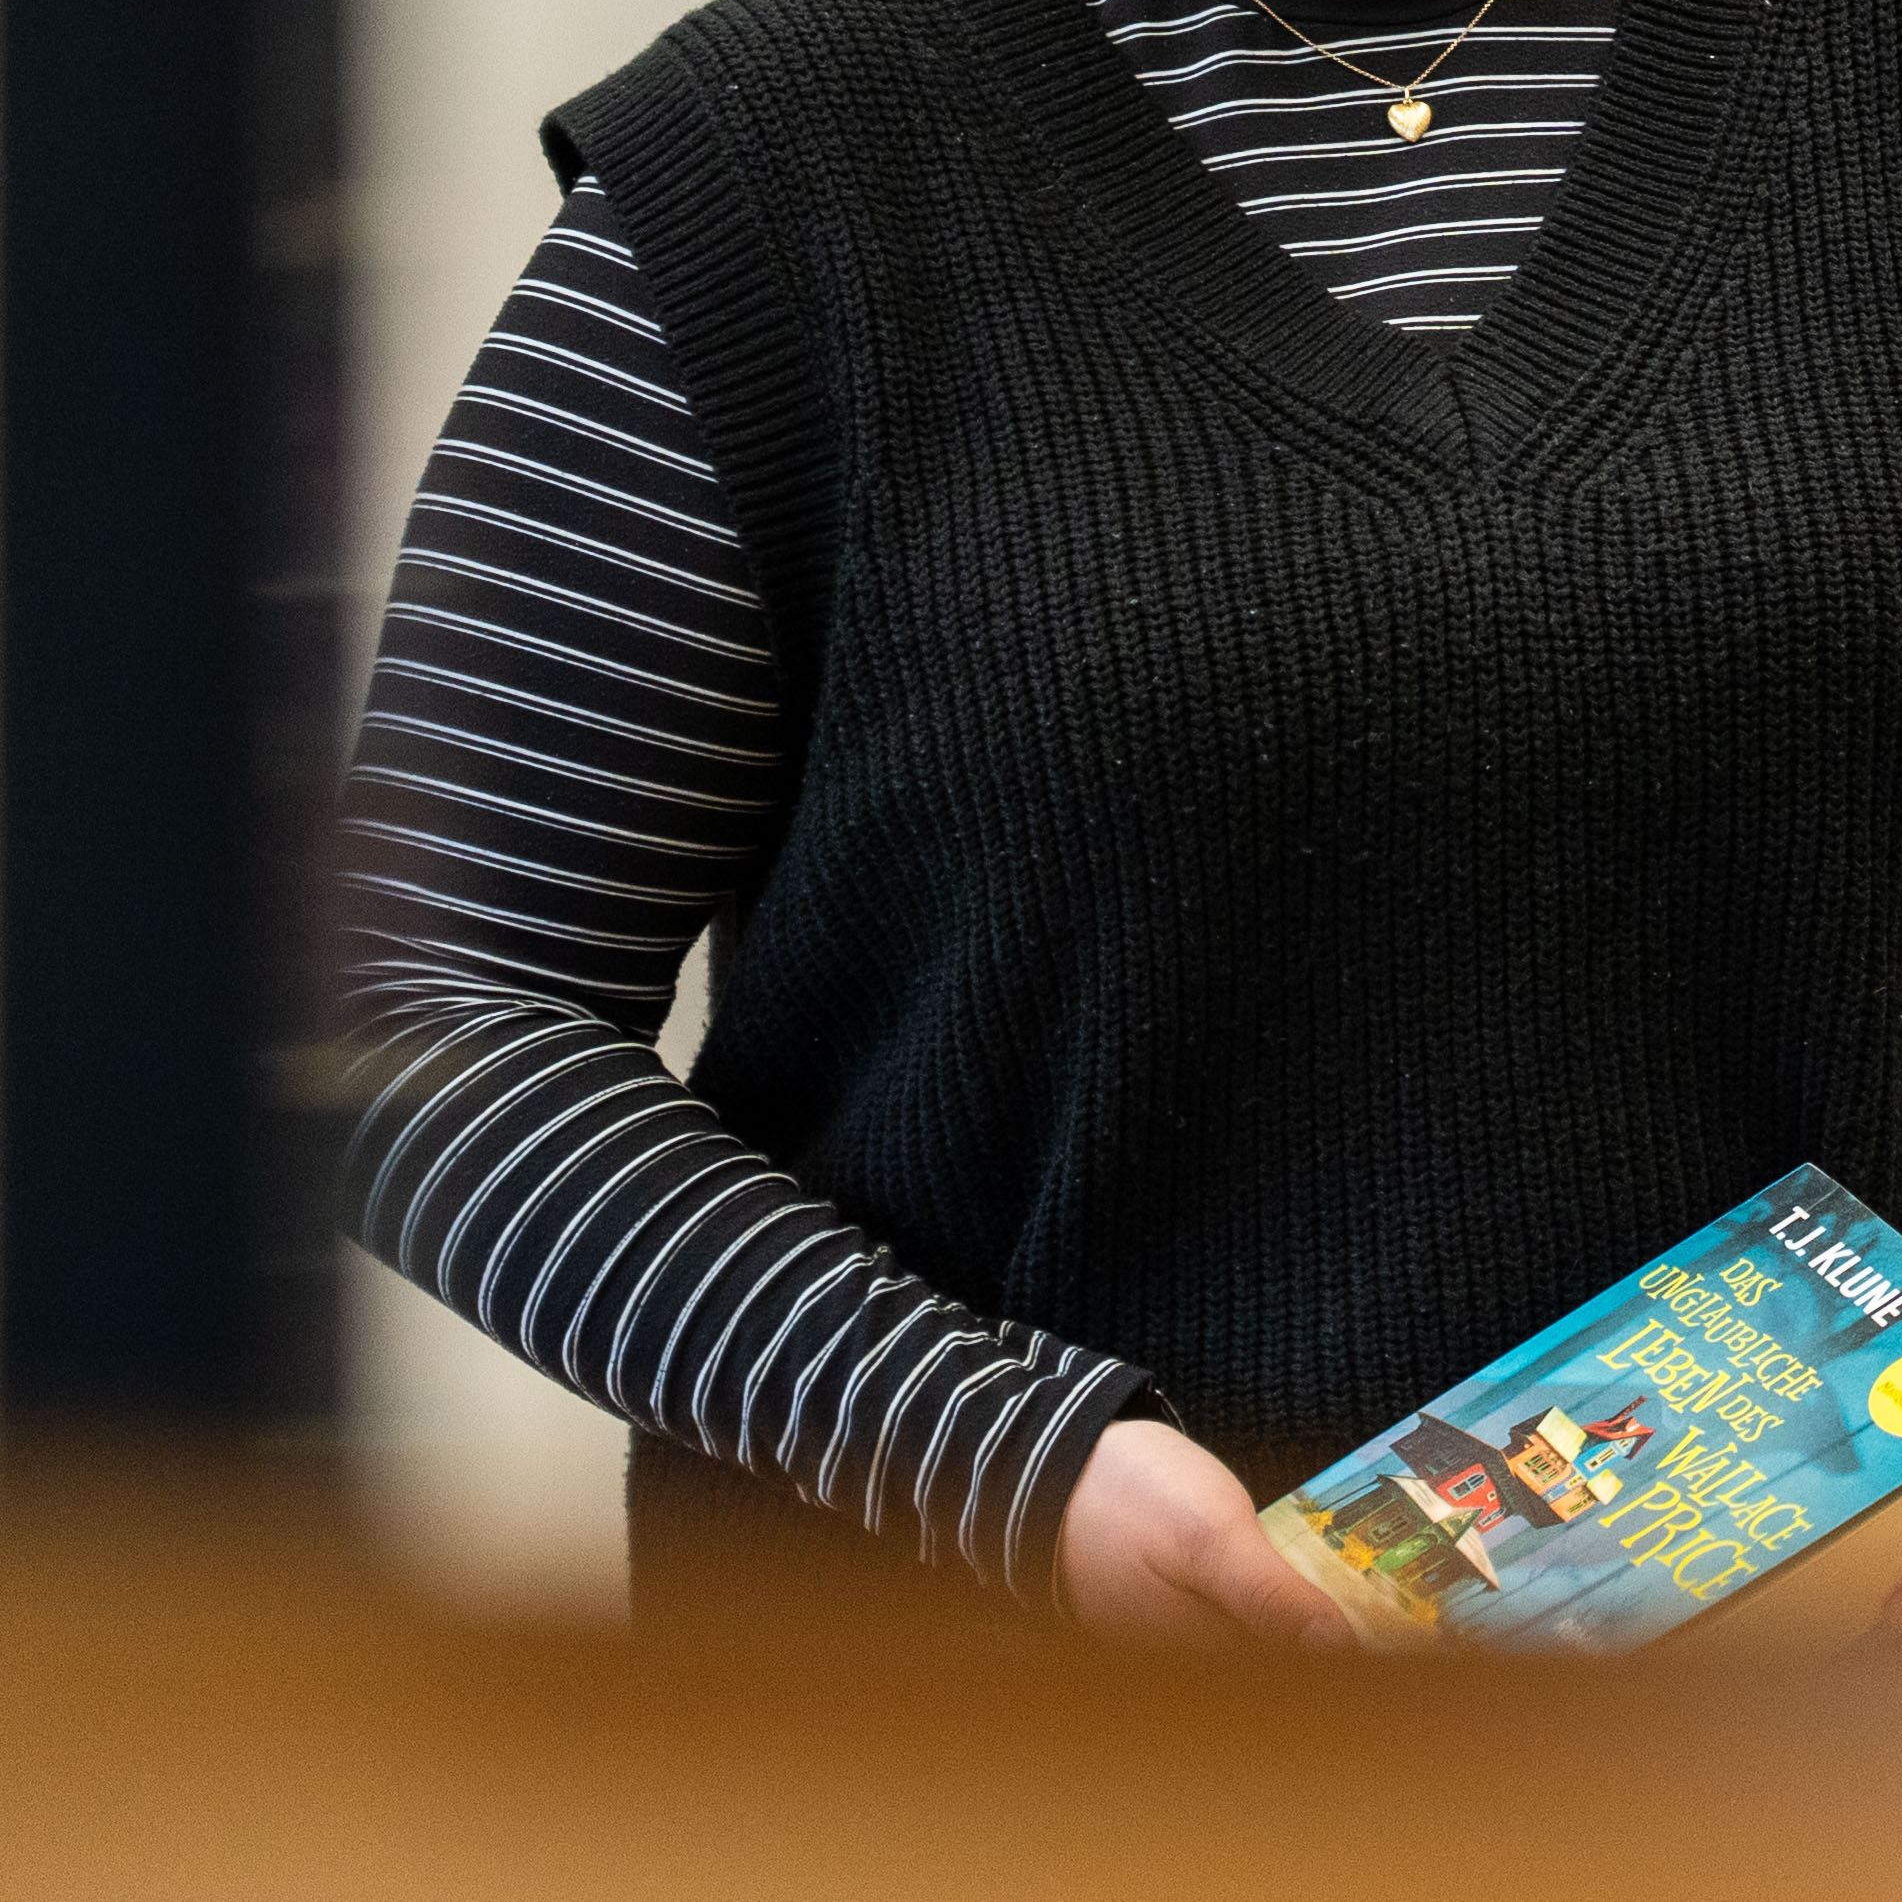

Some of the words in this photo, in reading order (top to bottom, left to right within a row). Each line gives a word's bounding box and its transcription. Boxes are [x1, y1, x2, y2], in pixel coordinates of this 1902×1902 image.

[1720, 1258, 1783, 1307] DAS
[1769, 1205, 1827, 1257] T.J.
[1597, 1319, 1755, 1414] LEBEN
[1716, 1394, 1784, 1443] DES
[1639, 1264, 1823, 1402] UNGLAUBLICHE
[1598, 1481, 1757, 1601] PRICE
[1656, 1425, 1814, 1551] WALLACE
